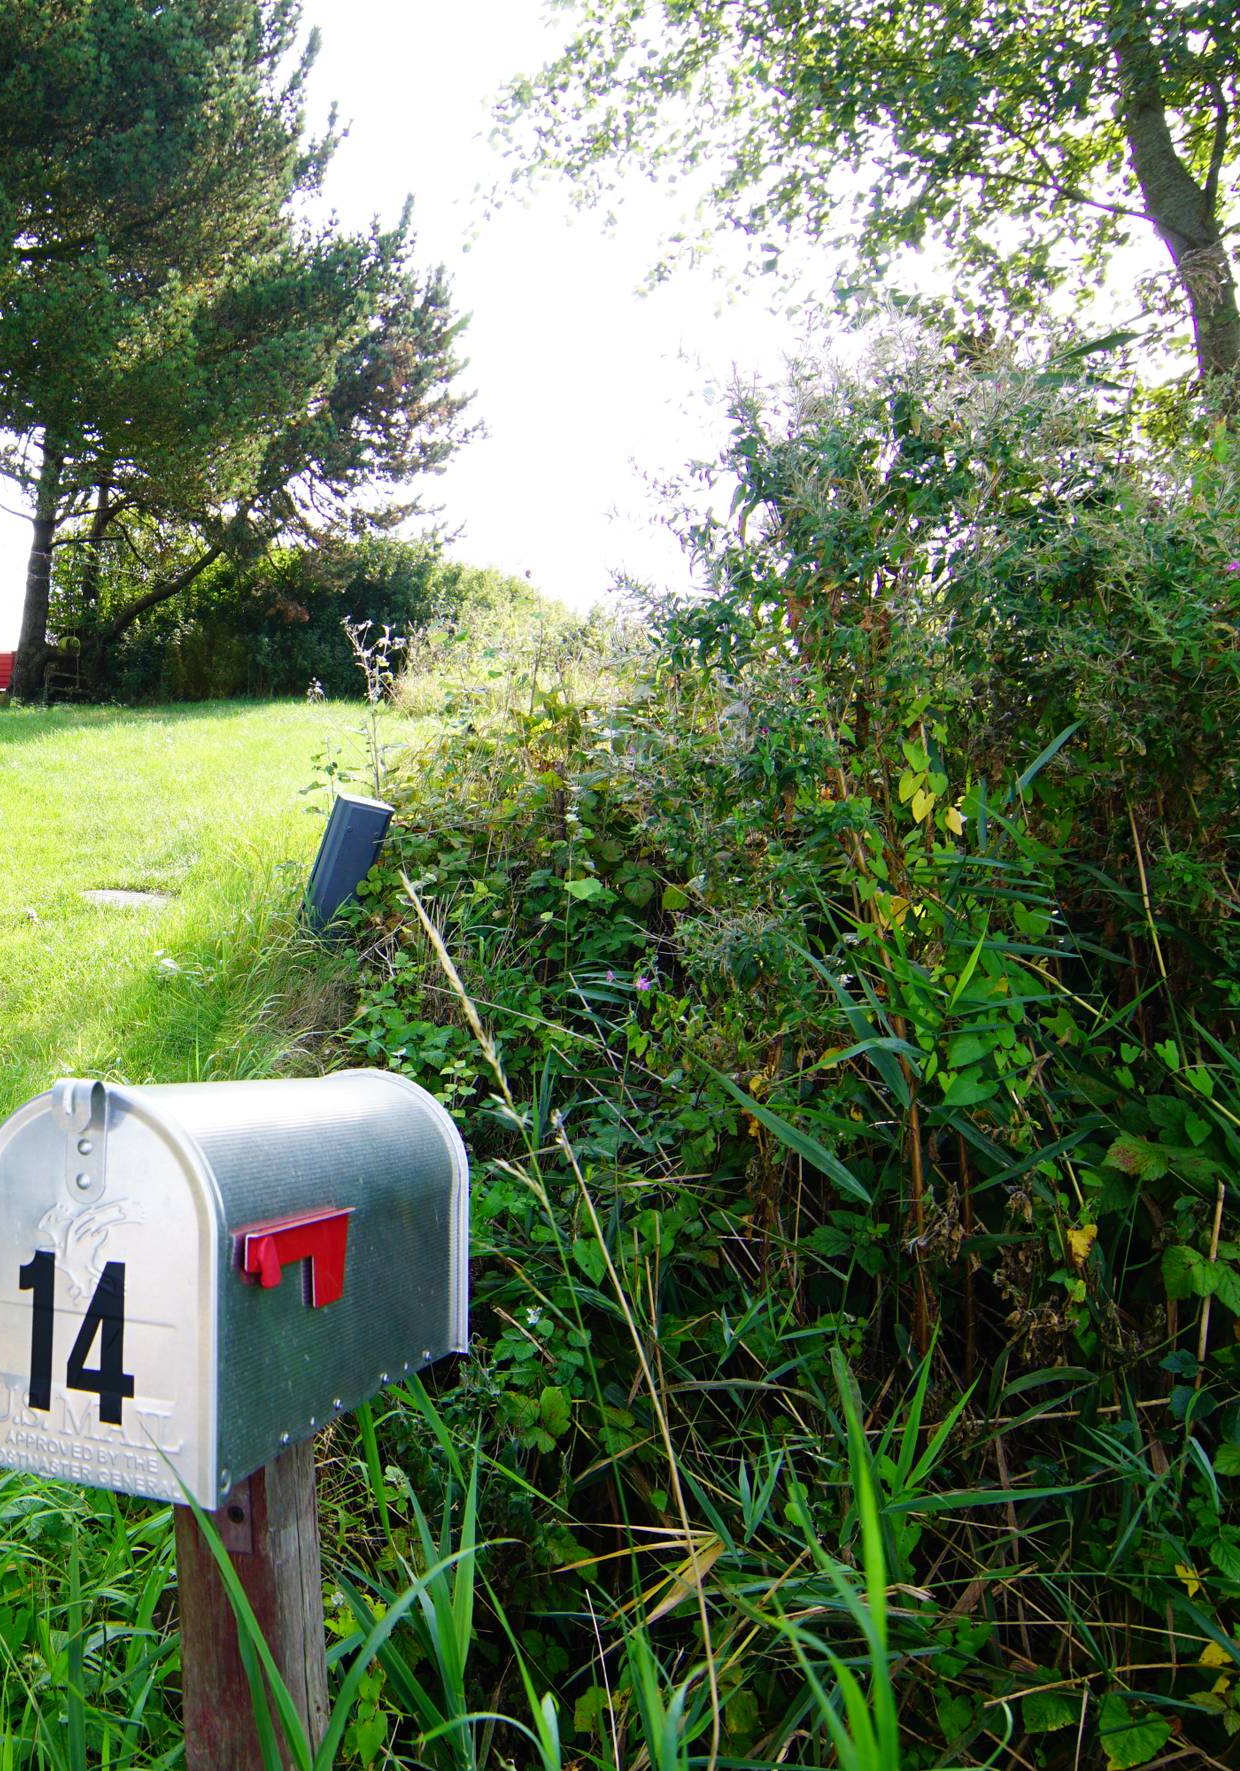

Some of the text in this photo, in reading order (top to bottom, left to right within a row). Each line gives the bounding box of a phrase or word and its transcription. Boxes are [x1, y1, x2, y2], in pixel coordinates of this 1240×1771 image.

[19, 1249, 135, 1425] 14
[5, 1429, 159, 1474] APPROVED BY THE
[97, 1467, 182, 1499] GENERAL
